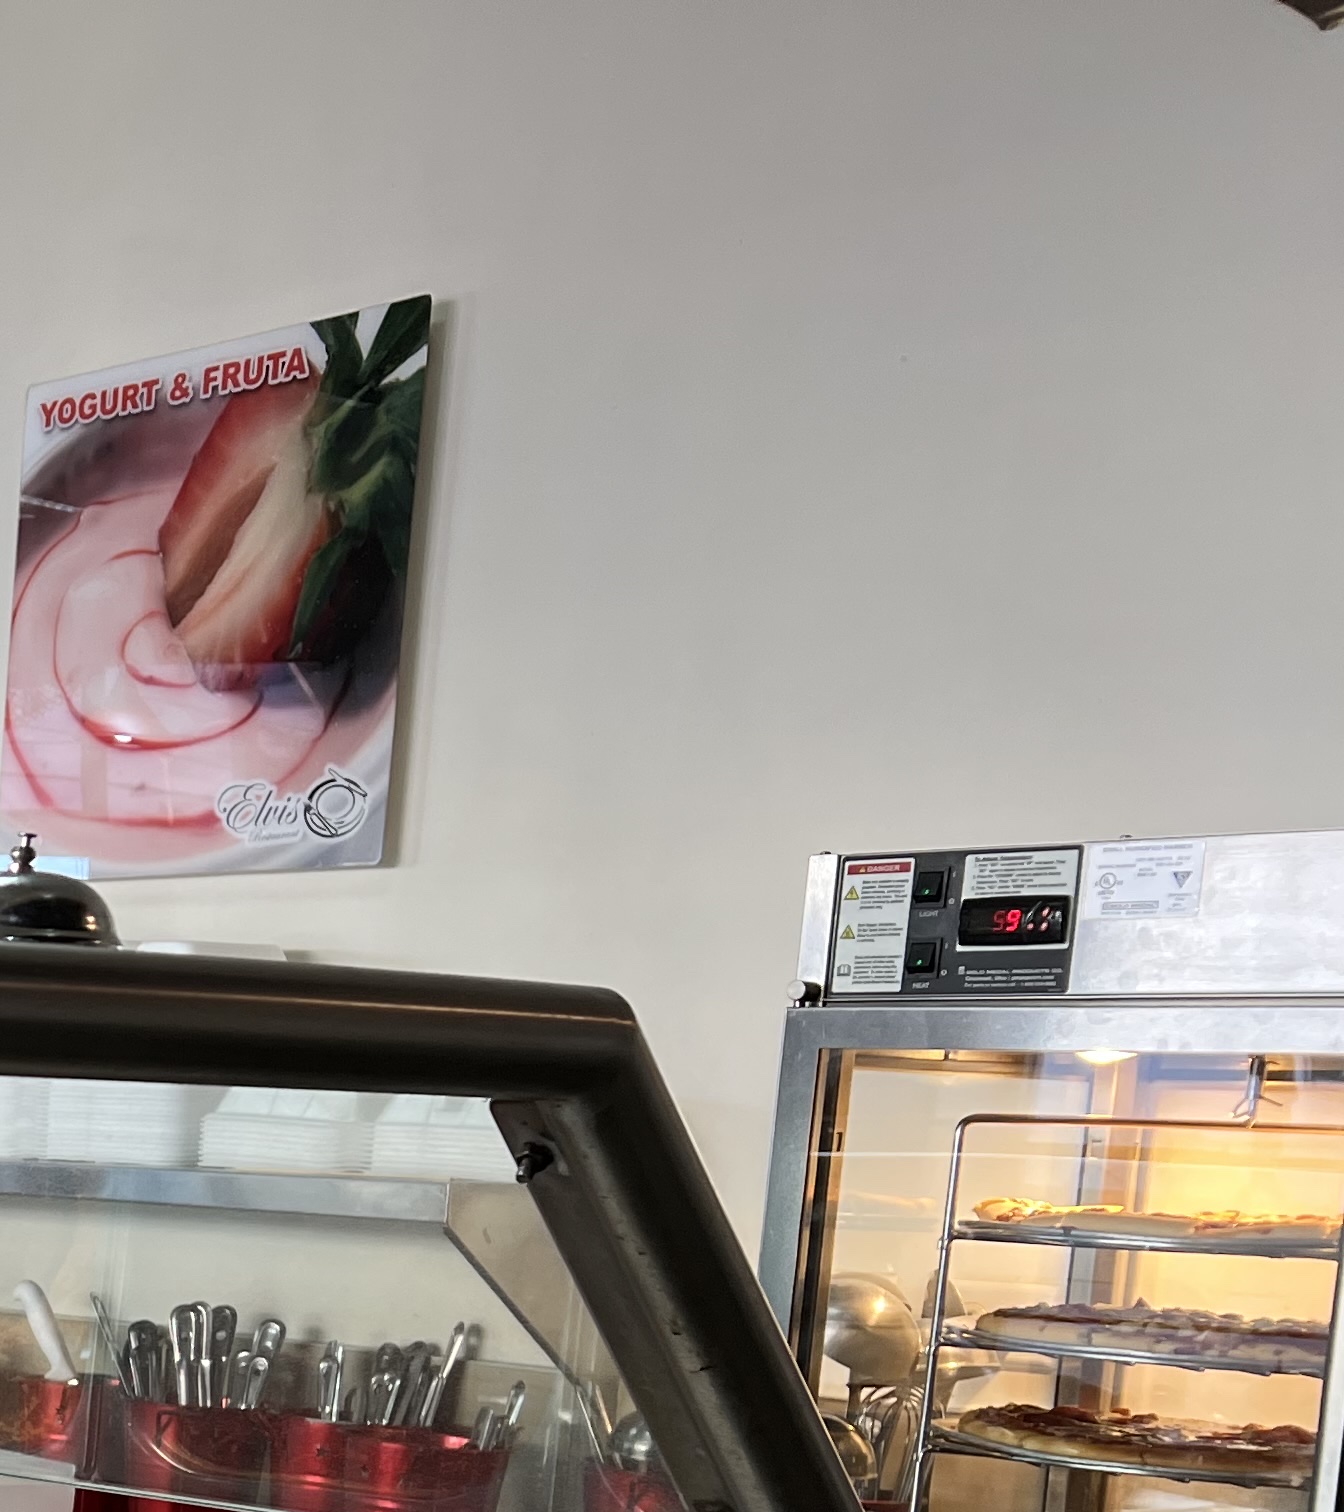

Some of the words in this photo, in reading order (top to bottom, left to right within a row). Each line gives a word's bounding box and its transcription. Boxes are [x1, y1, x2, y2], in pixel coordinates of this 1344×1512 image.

[39, 377, 161, 430] YOGURT
[169, 372, 190, 402] &
[202, 347, 308, 395] FRUTA
[217, 782, 301, 834] Elvis
